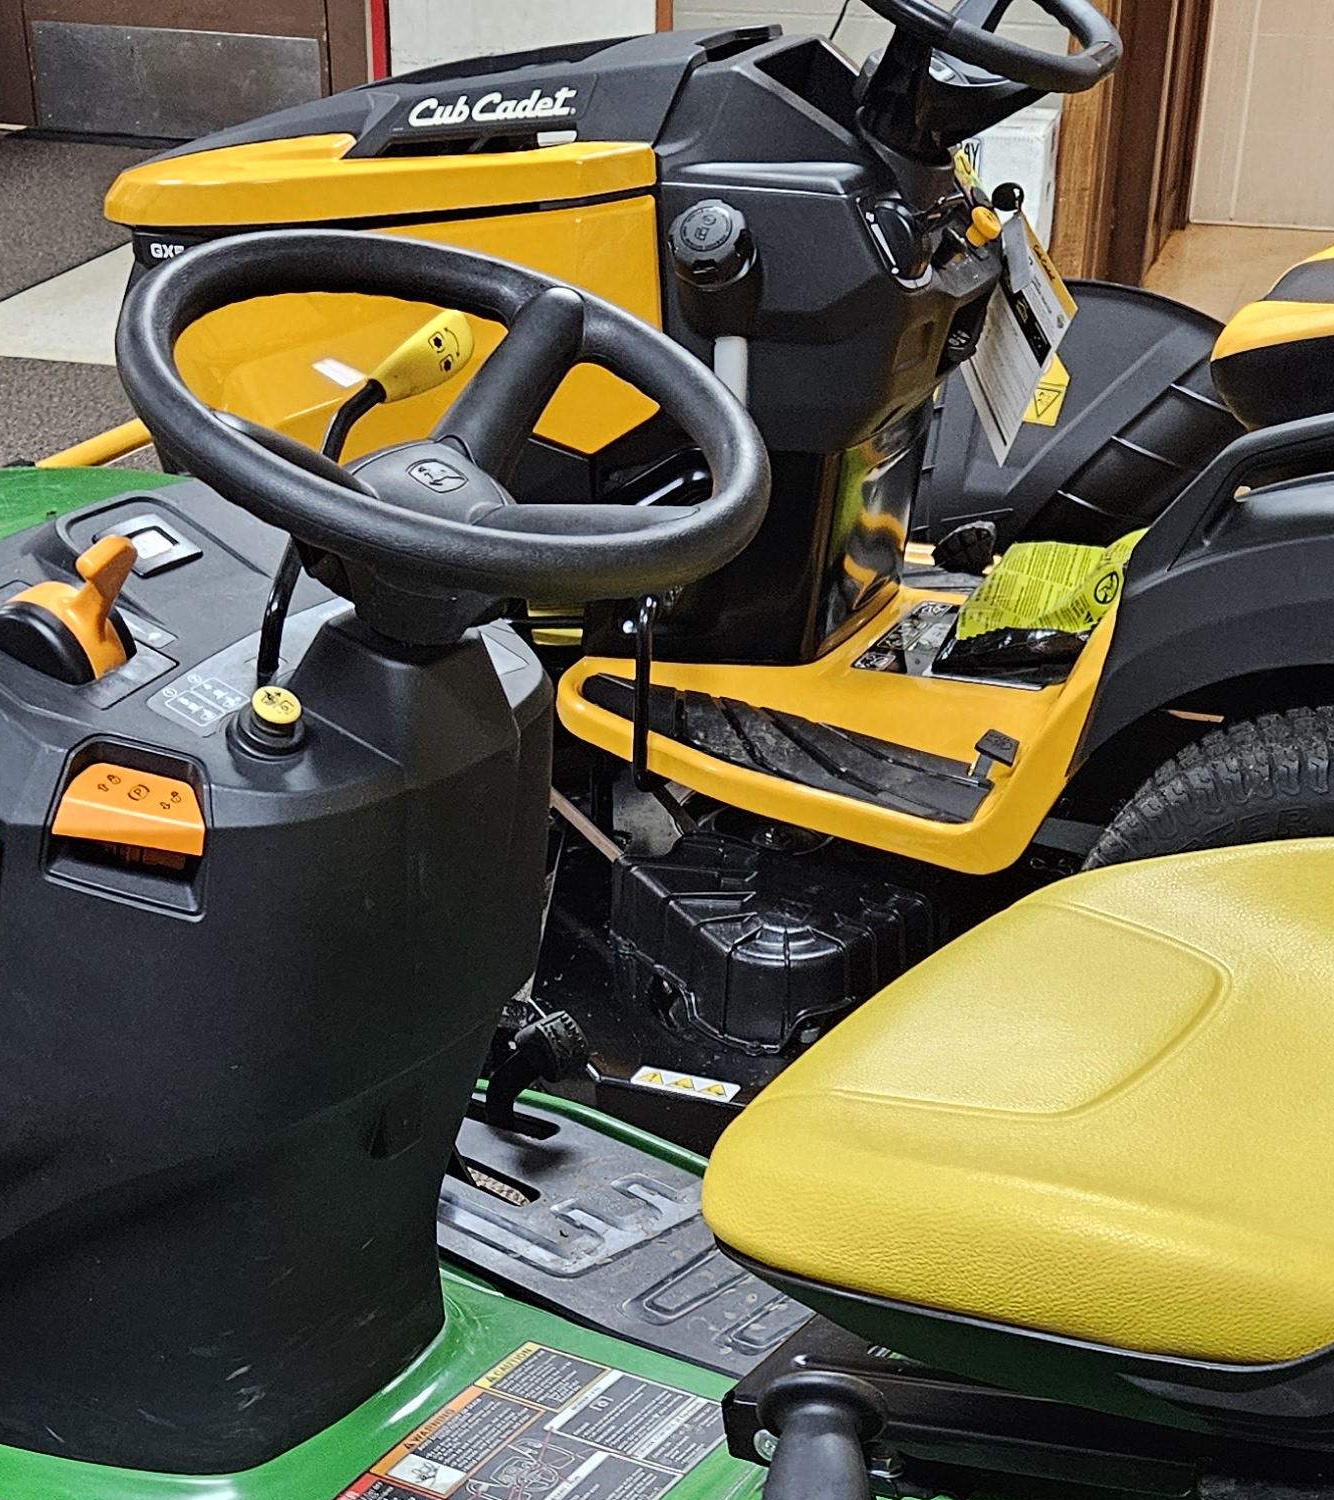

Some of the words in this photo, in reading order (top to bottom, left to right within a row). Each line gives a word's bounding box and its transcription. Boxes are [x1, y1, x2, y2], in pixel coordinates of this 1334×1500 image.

[408, 96, 470, 127] Cub
[471, 87, 578, 121] Cadet
[494, 1347, 532, 1378] CAUTION
[411, 1408, 456, 1445] WARNING
